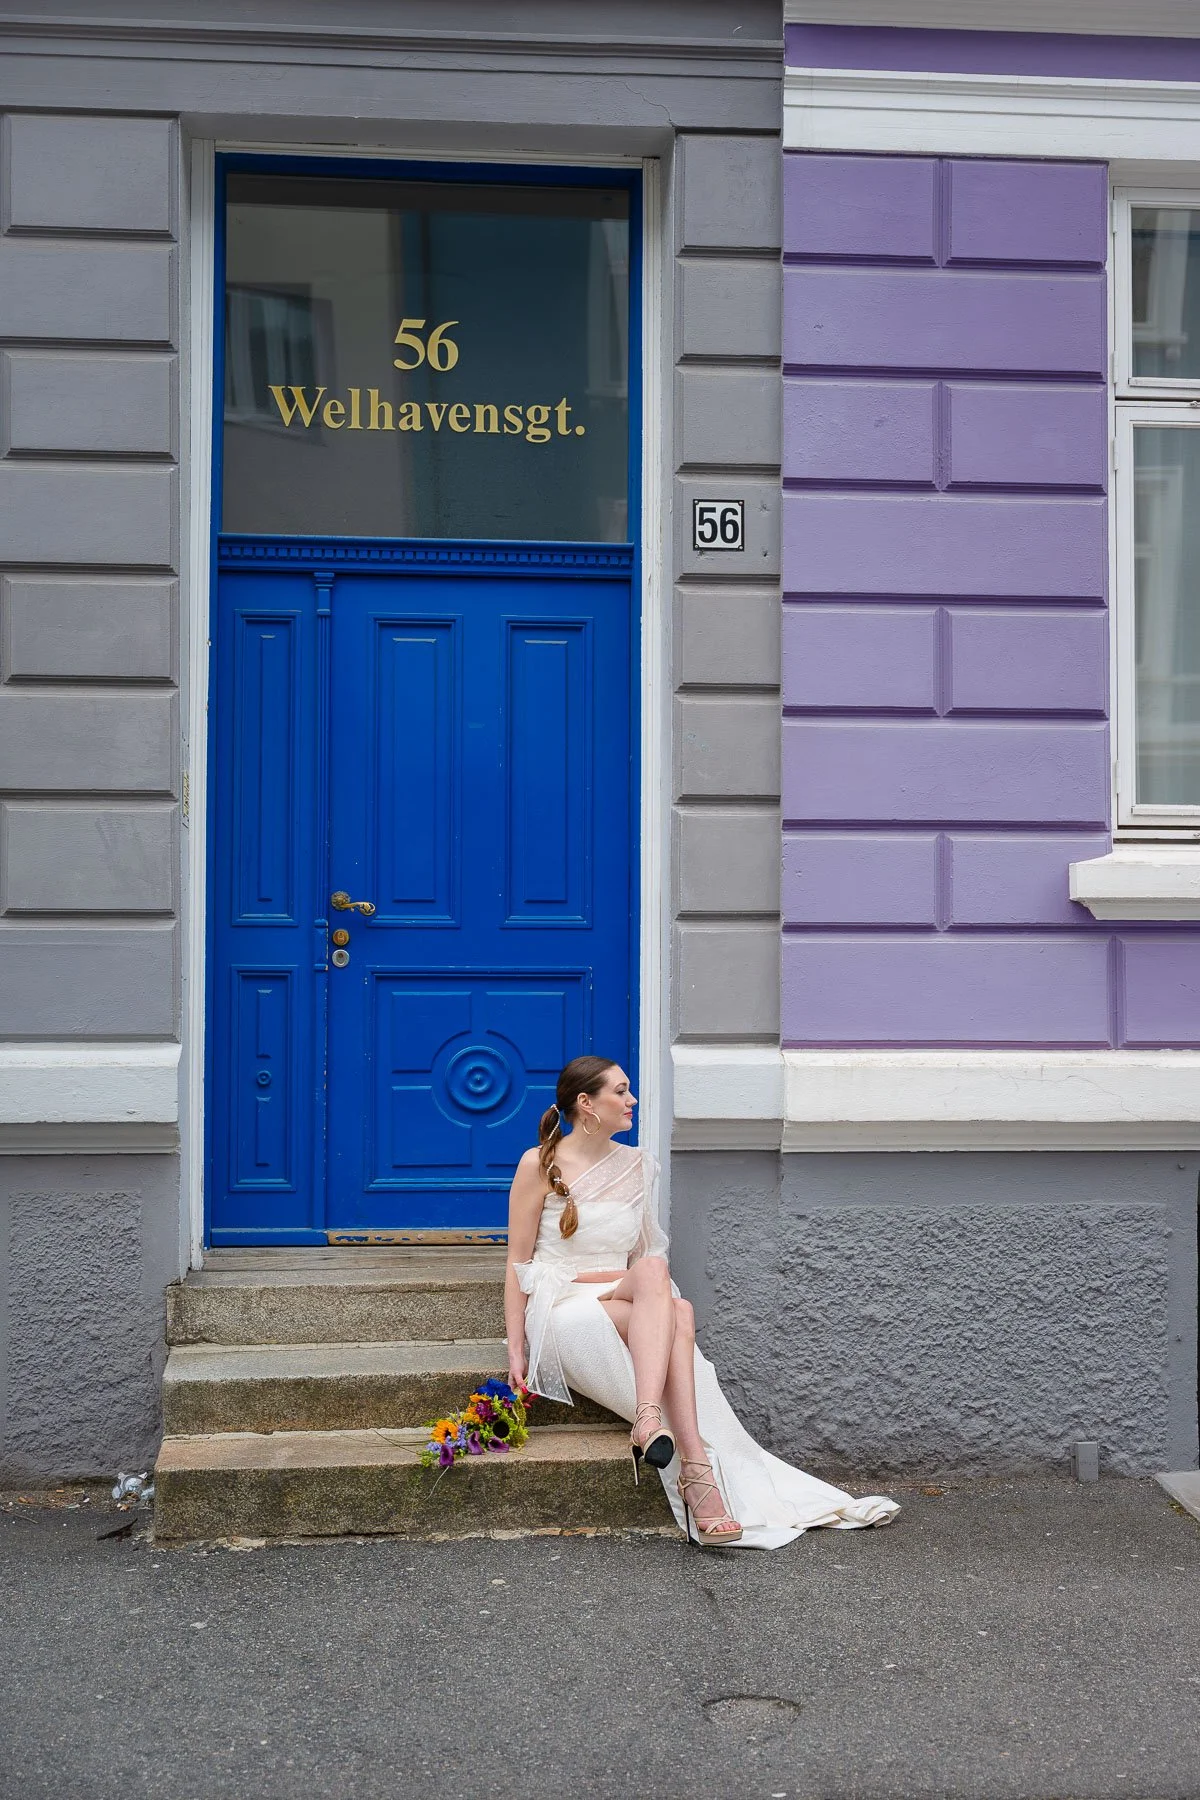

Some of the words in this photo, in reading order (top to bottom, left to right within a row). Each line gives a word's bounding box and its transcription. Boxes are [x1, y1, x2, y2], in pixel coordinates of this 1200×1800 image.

[393, 318, 460, 372] 56
[268, 385, 586, 443] Welhavensgt.
[698, 506, 740, 544] 56
